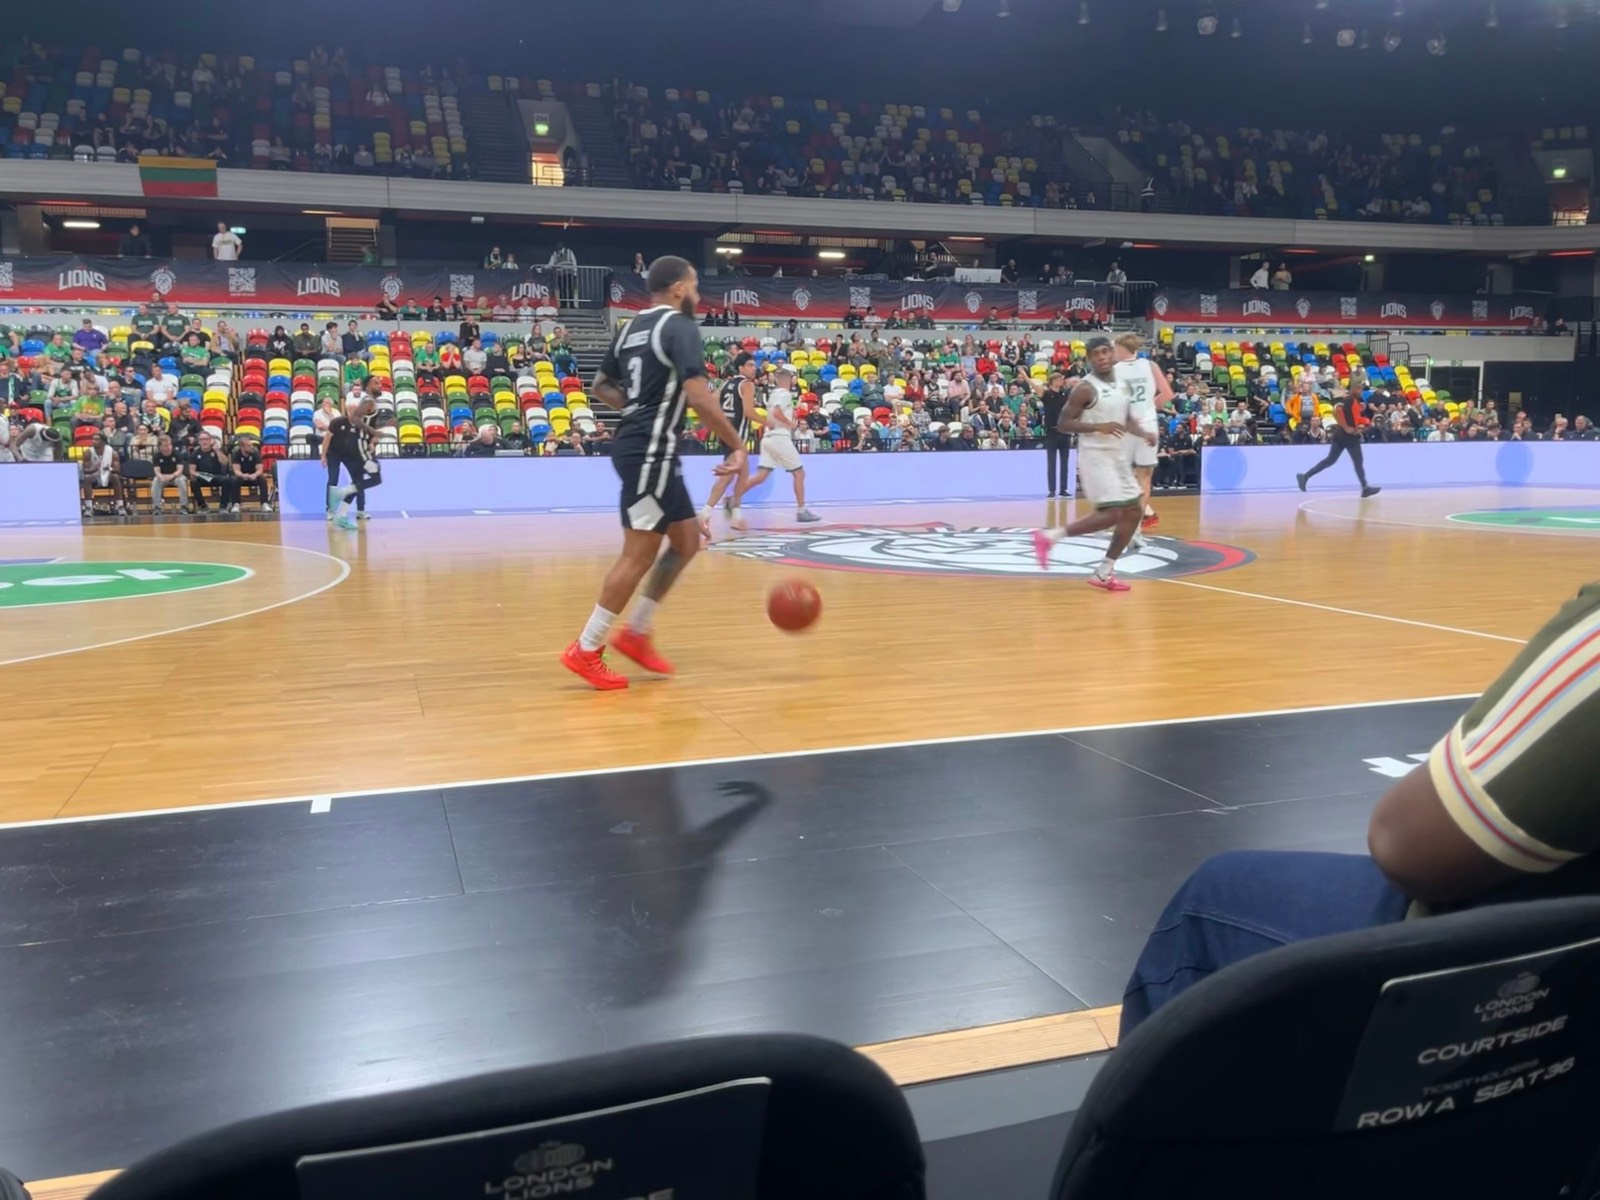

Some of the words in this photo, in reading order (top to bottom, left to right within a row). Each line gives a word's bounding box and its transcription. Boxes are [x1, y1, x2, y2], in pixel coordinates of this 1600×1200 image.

[59, 270, 106, 291] LIONS
[297, 277, 341, 297] LIONS
[511, 283, 549, 301] LIONS
[723, 289, 760, 307] LIONS
[902, 294, 935, 311] LIONS
[1065, 298, 1095, 312] LIONS
[1243, 300, 1271, 316] LIONS
[1381, 303, 1407, 318] LIONS
[627, 357, 642, 399] 3
[723, 392, 735, 411] 21
[1474, 988, 1550, 1014] LONDON
[1481, 1002, 1535, 1022] LIONS
[1417, 1014, 1569, 1065] COURTSIDE
[1357, 1101, 1433, 1129] ROW
[1434, 1097, 1456, 1114] A
[1473, 1069, 1545, 1104] SEAT
[1544, 1057, 1576, 1080] 36
[484, 1157, 614, 1195] LONDON
[505, 1174, 595, 1200] LIONS
